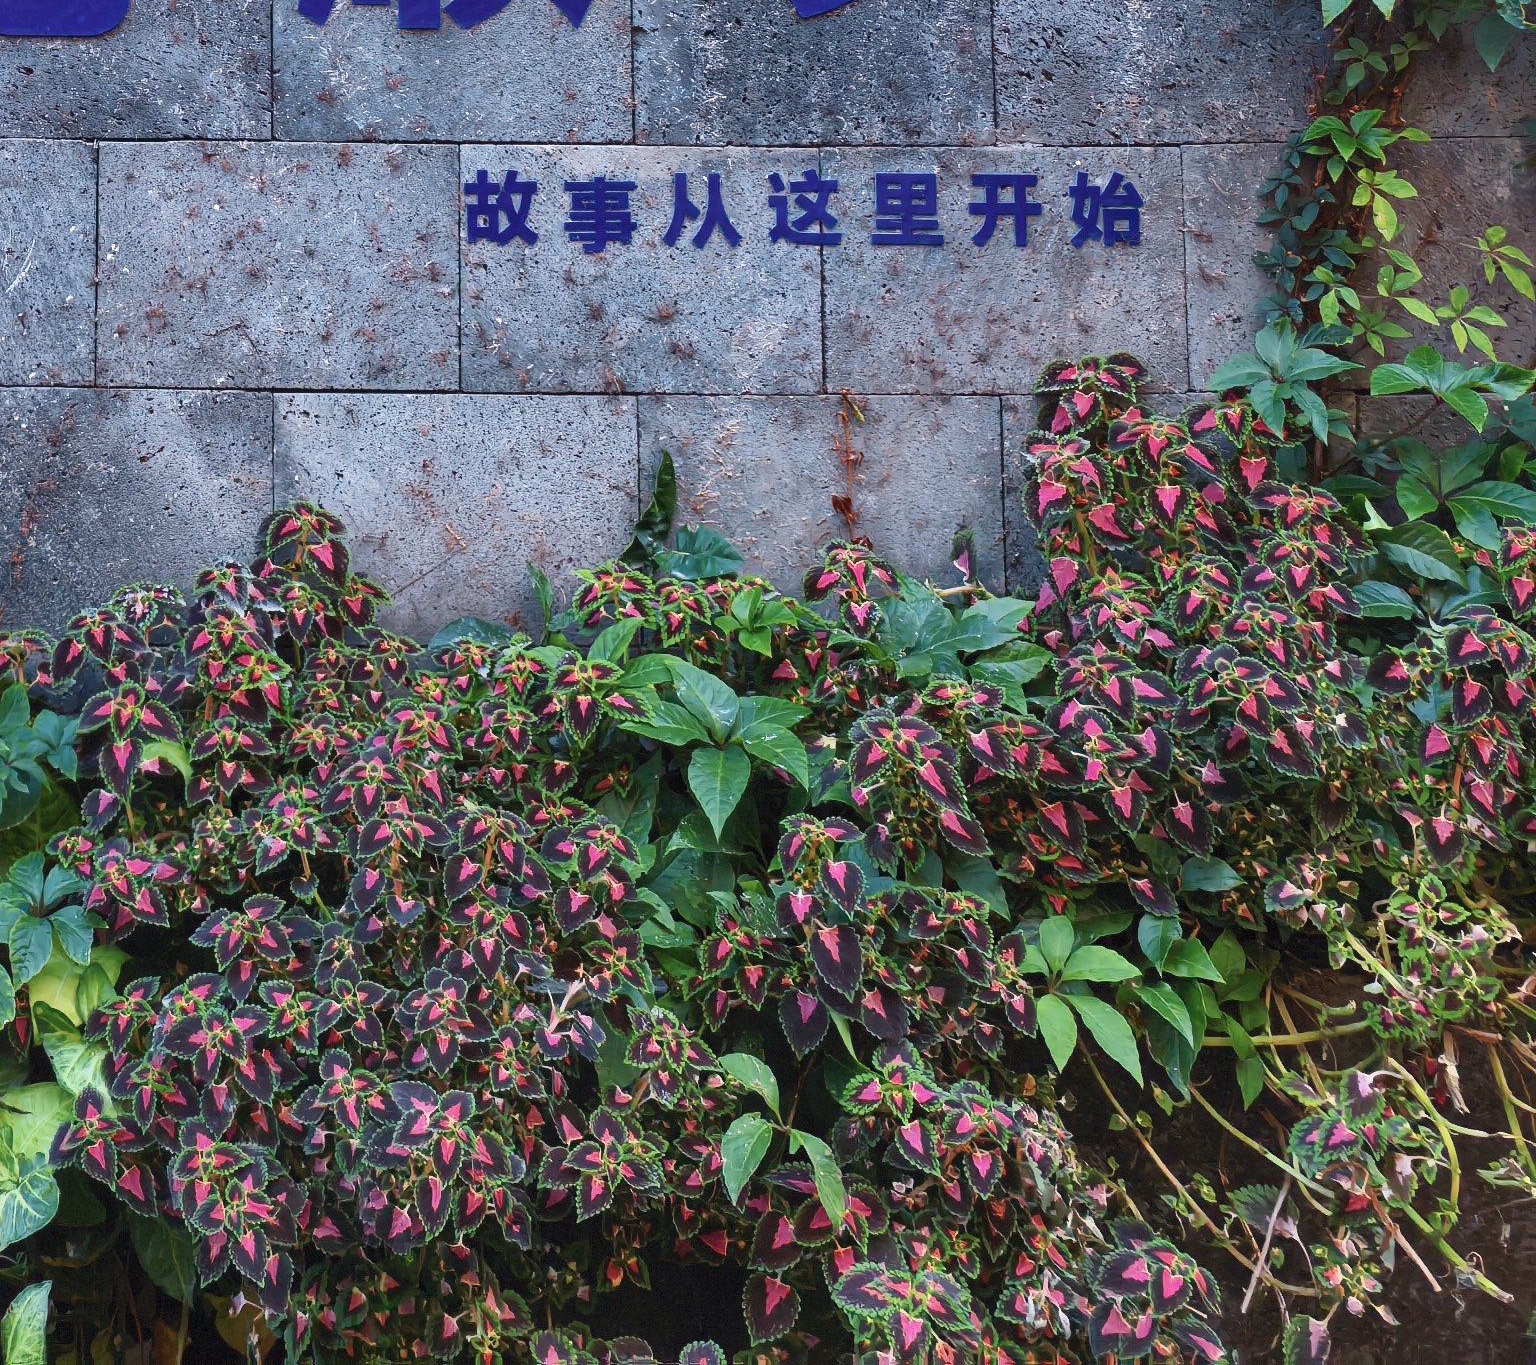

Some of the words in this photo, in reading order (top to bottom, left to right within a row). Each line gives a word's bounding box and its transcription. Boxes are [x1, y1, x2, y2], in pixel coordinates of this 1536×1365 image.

[464, 168, 1145, 255] 故事从这里开始
